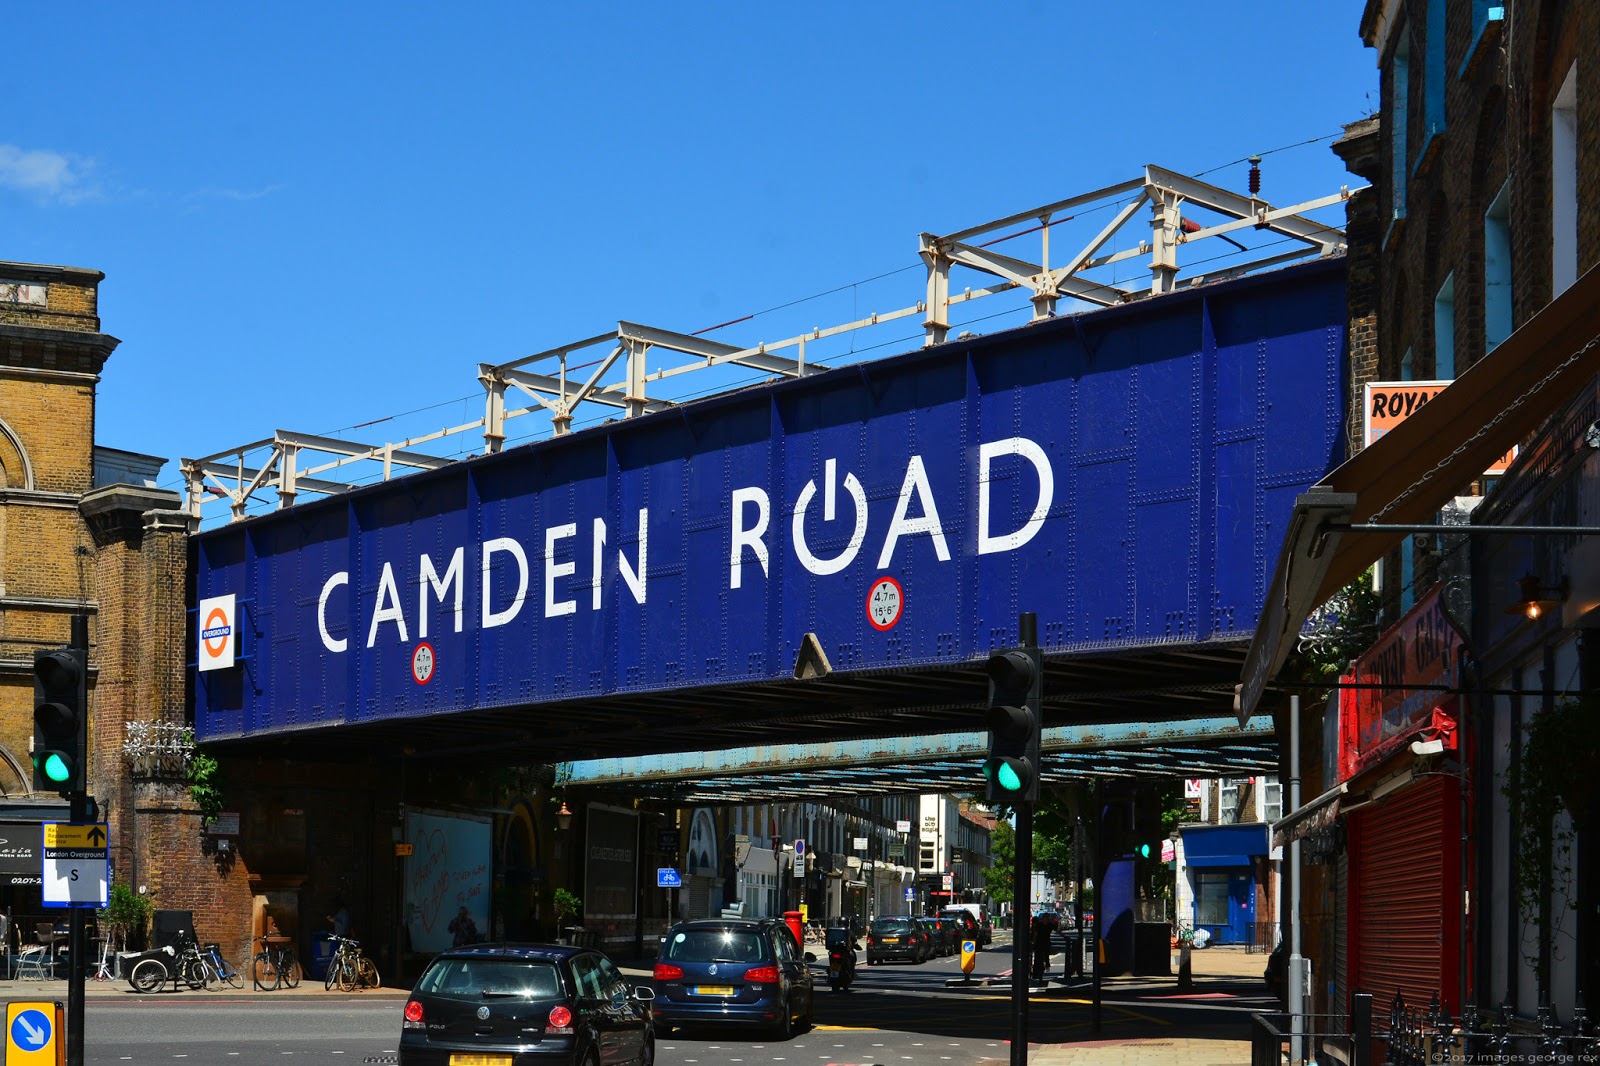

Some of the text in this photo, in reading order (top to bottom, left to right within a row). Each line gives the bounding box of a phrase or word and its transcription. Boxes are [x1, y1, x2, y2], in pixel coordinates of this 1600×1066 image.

[317, 436, 1055, 653] CAMDEN ROAD
[874, 591, 896, 602] 4.7m
[203, 627, 229, 638] OVERGROUND
[416, 654, 431, 662] 4.7m
[70, 851, 105, 859] Overground
[70, 869, 79, 881] S
